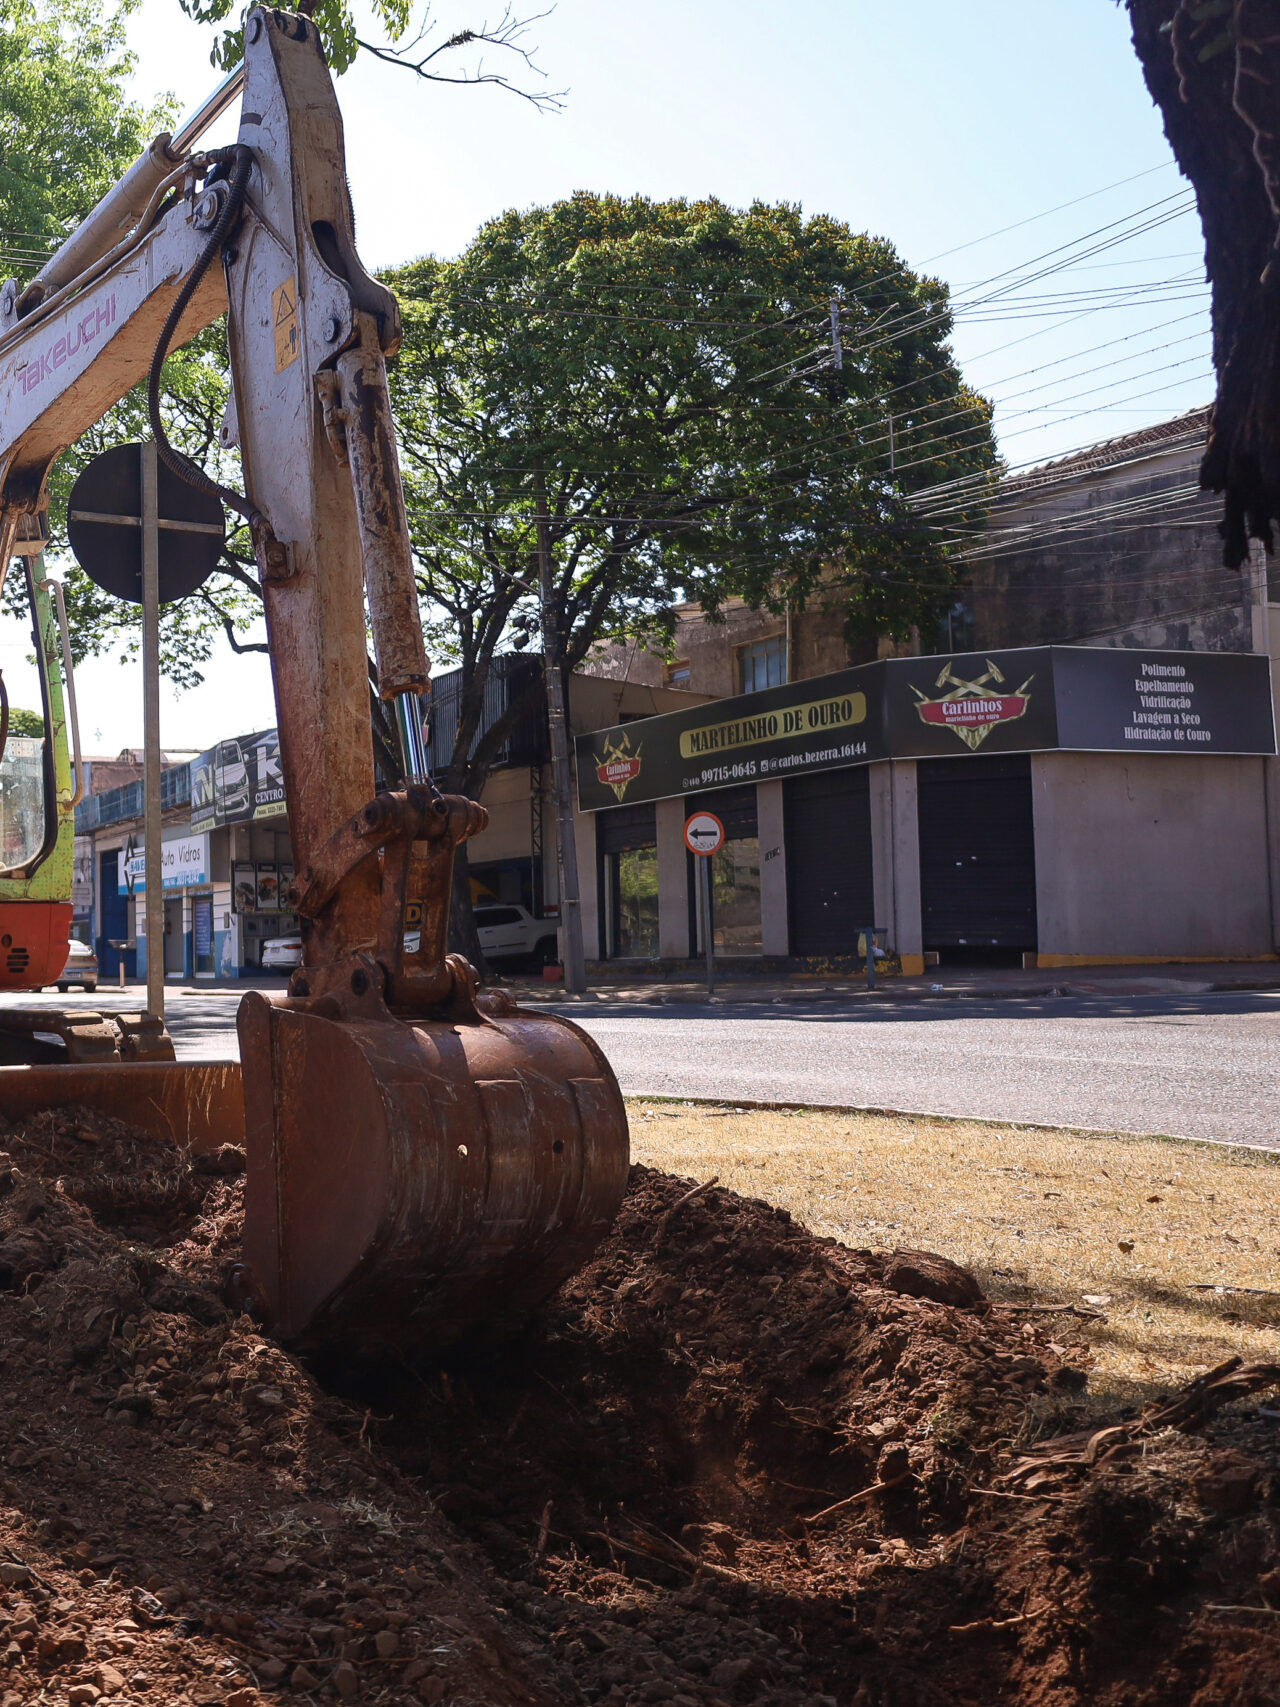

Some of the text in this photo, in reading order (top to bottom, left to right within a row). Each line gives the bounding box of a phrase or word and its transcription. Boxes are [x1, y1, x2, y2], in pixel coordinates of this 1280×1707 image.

[1141, 663, 1186, 677] Polimento
[1135, 679, 1195, 693] Espelhamento
[941, 699, 1003, 716] Carlinhos
[1140, 695, 1192, 710] Vidrificação
[689, 698, 853, 753] MARTELINHO DE OURO
[1133, 711, 1201, 725] Lavagem a Seco
[1124, 726, 1212, 741] Hidratação de Couro
[701, 760, 757, 784] 99715-0645
[254, 787, 284, 804] CENTRO
[178, 843, 200, 862] Vidros
